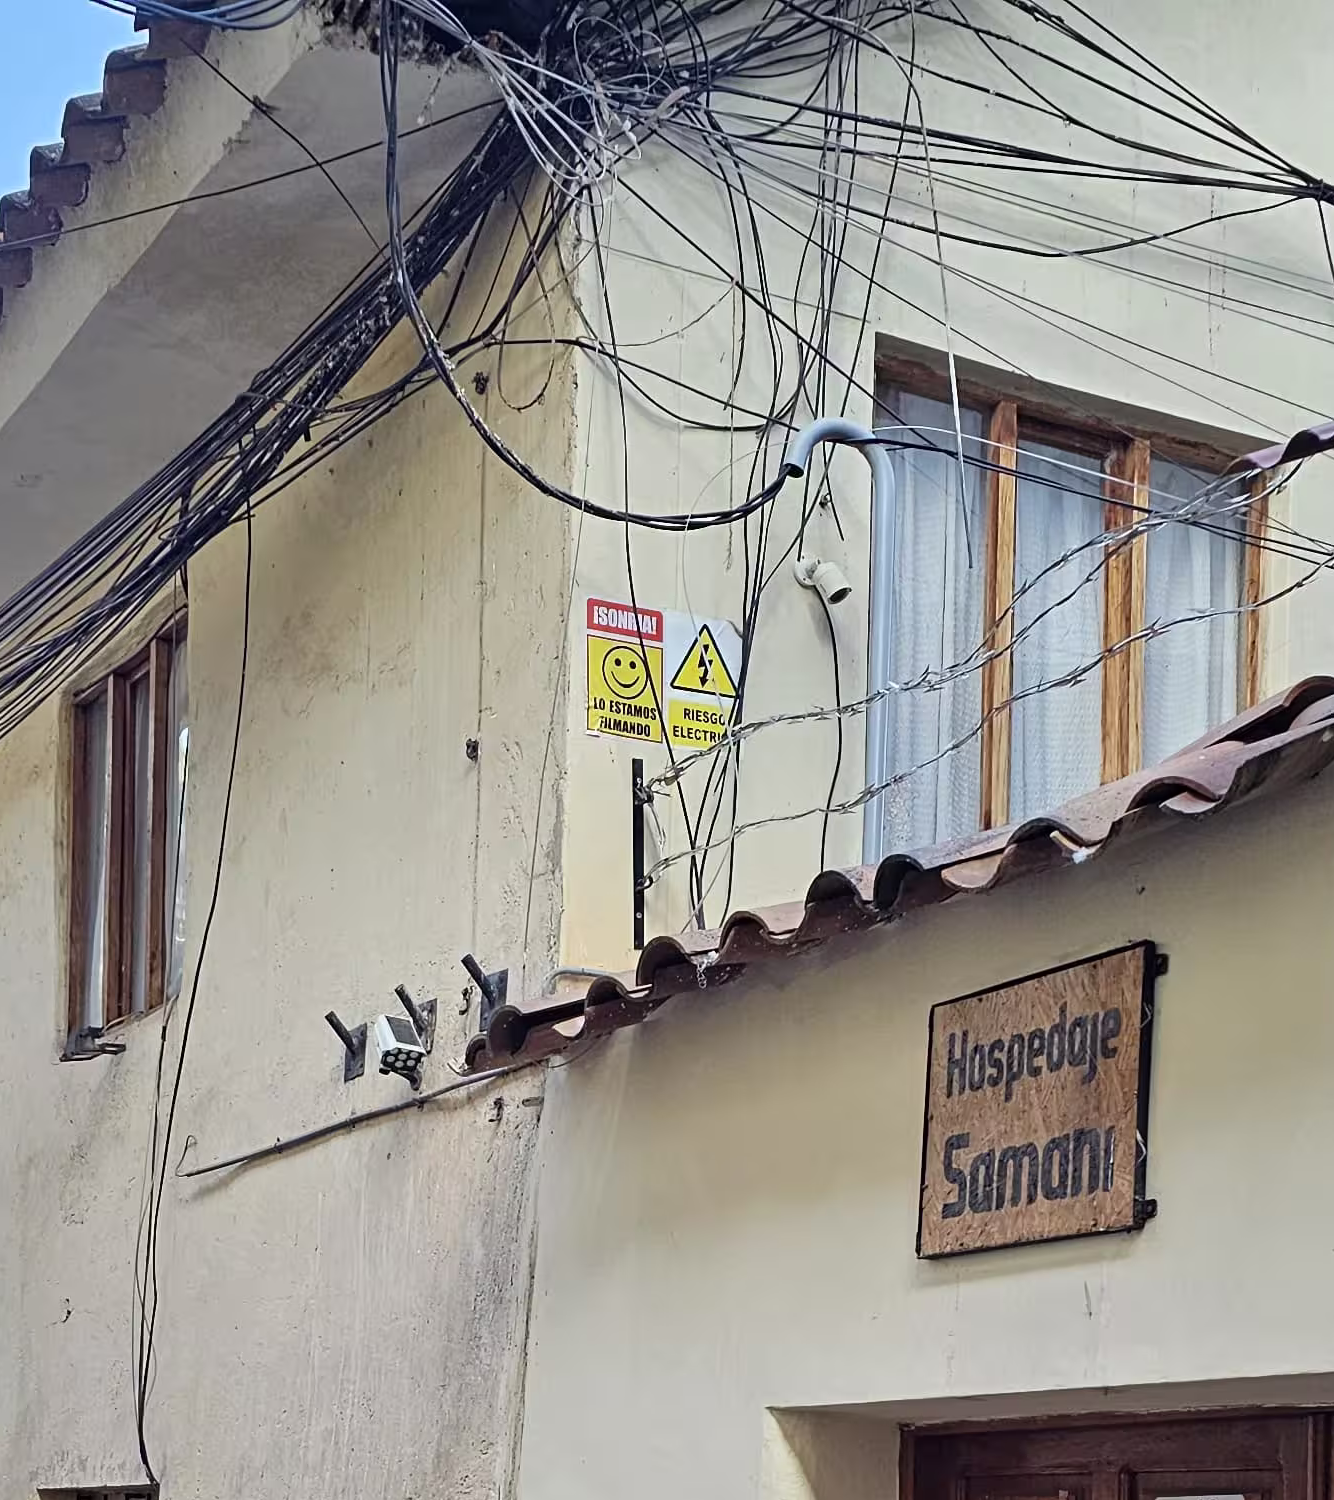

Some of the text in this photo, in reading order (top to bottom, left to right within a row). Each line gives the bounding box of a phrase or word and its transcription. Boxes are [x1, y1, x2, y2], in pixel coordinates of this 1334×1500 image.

[593, 697, 657, 721] LO ESTAMOS
[946, 1003, 1121, 1103] Hospedaje
[942, 1125, 1116, 1219] Samani
